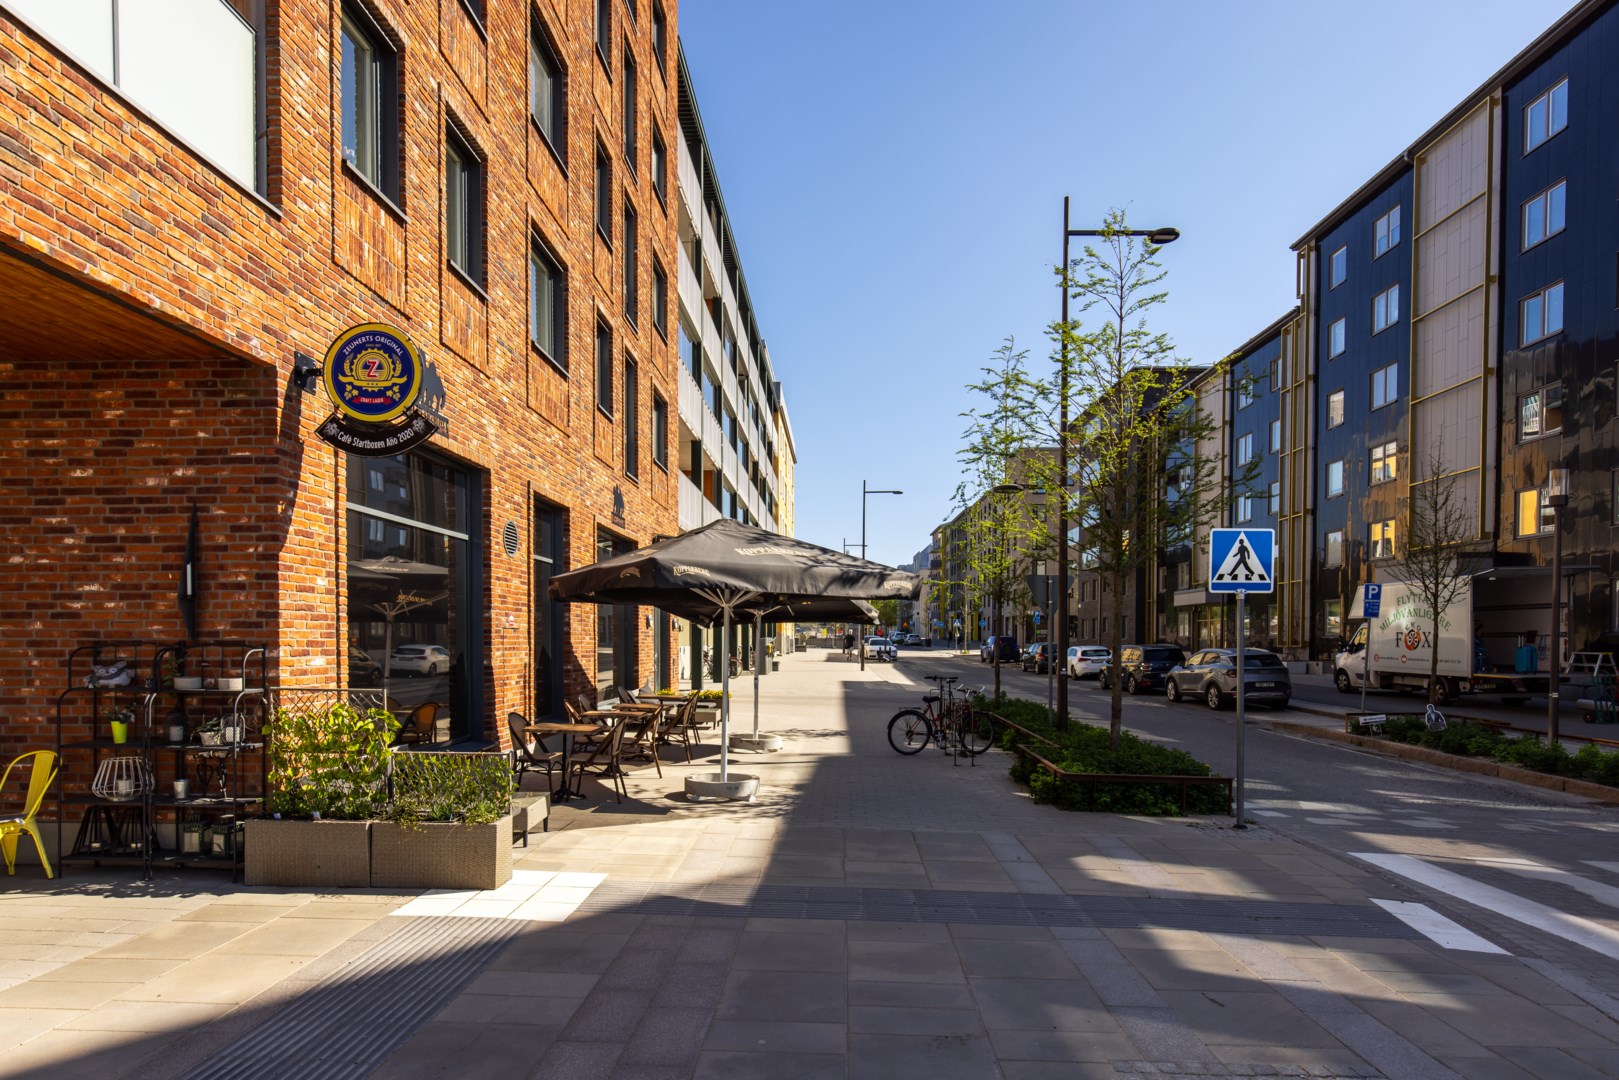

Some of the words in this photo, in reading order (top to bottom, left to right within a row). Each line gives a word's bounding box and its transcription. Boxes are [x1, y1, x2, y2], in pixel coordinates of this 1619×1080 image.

[343, 336, 373, 355] ZEUNERTS
[375, 335, 403, 356] ORIGINAL
[367, 359, 379, 378] Z
[337, 431, 352, 445] Café
[352, 437, 386, 449] Startboxen
[398, 428, 414, 443] 2020
[1368, 586, 1379, 599] P
